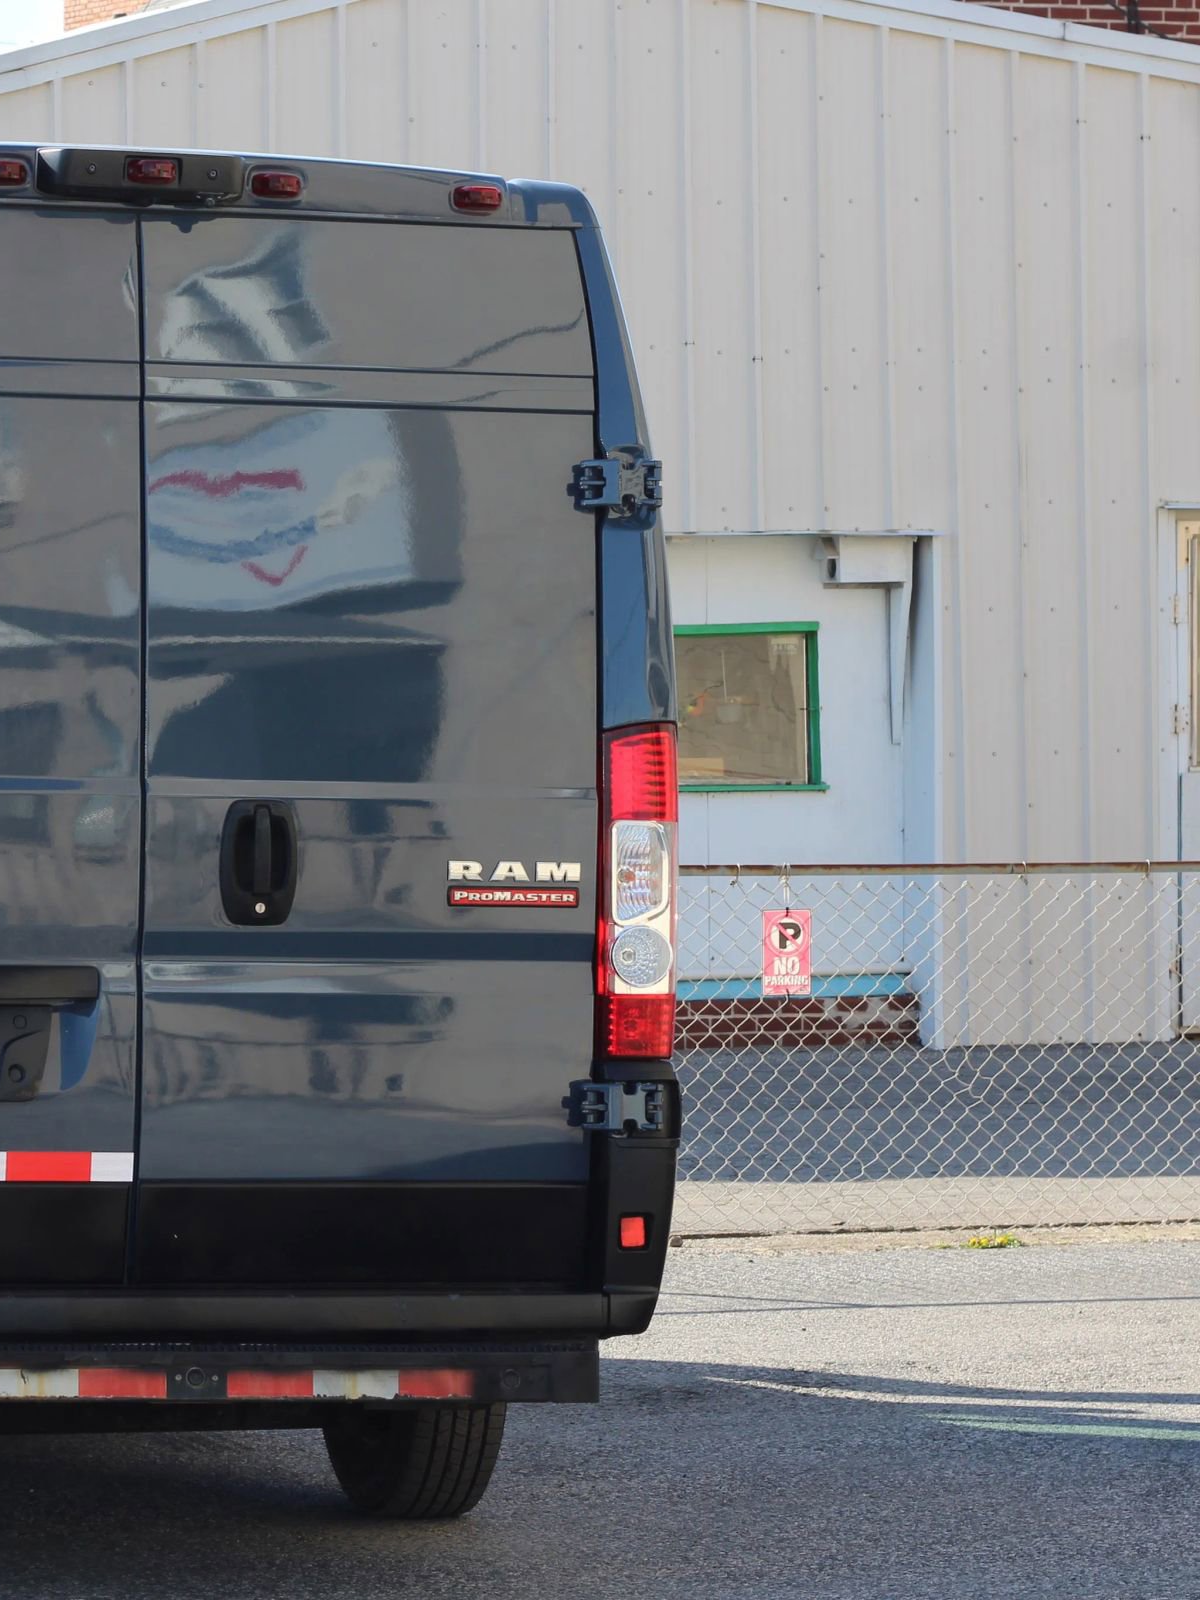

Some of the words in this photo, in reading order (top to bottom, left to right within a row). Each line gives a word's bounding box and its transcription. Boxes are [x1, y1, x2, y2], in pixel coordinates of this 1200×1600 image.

[447, 860, 581, 882] RAM
[773, 956, 800, 976] NO
[764, 975, 809, 986] PARKING
